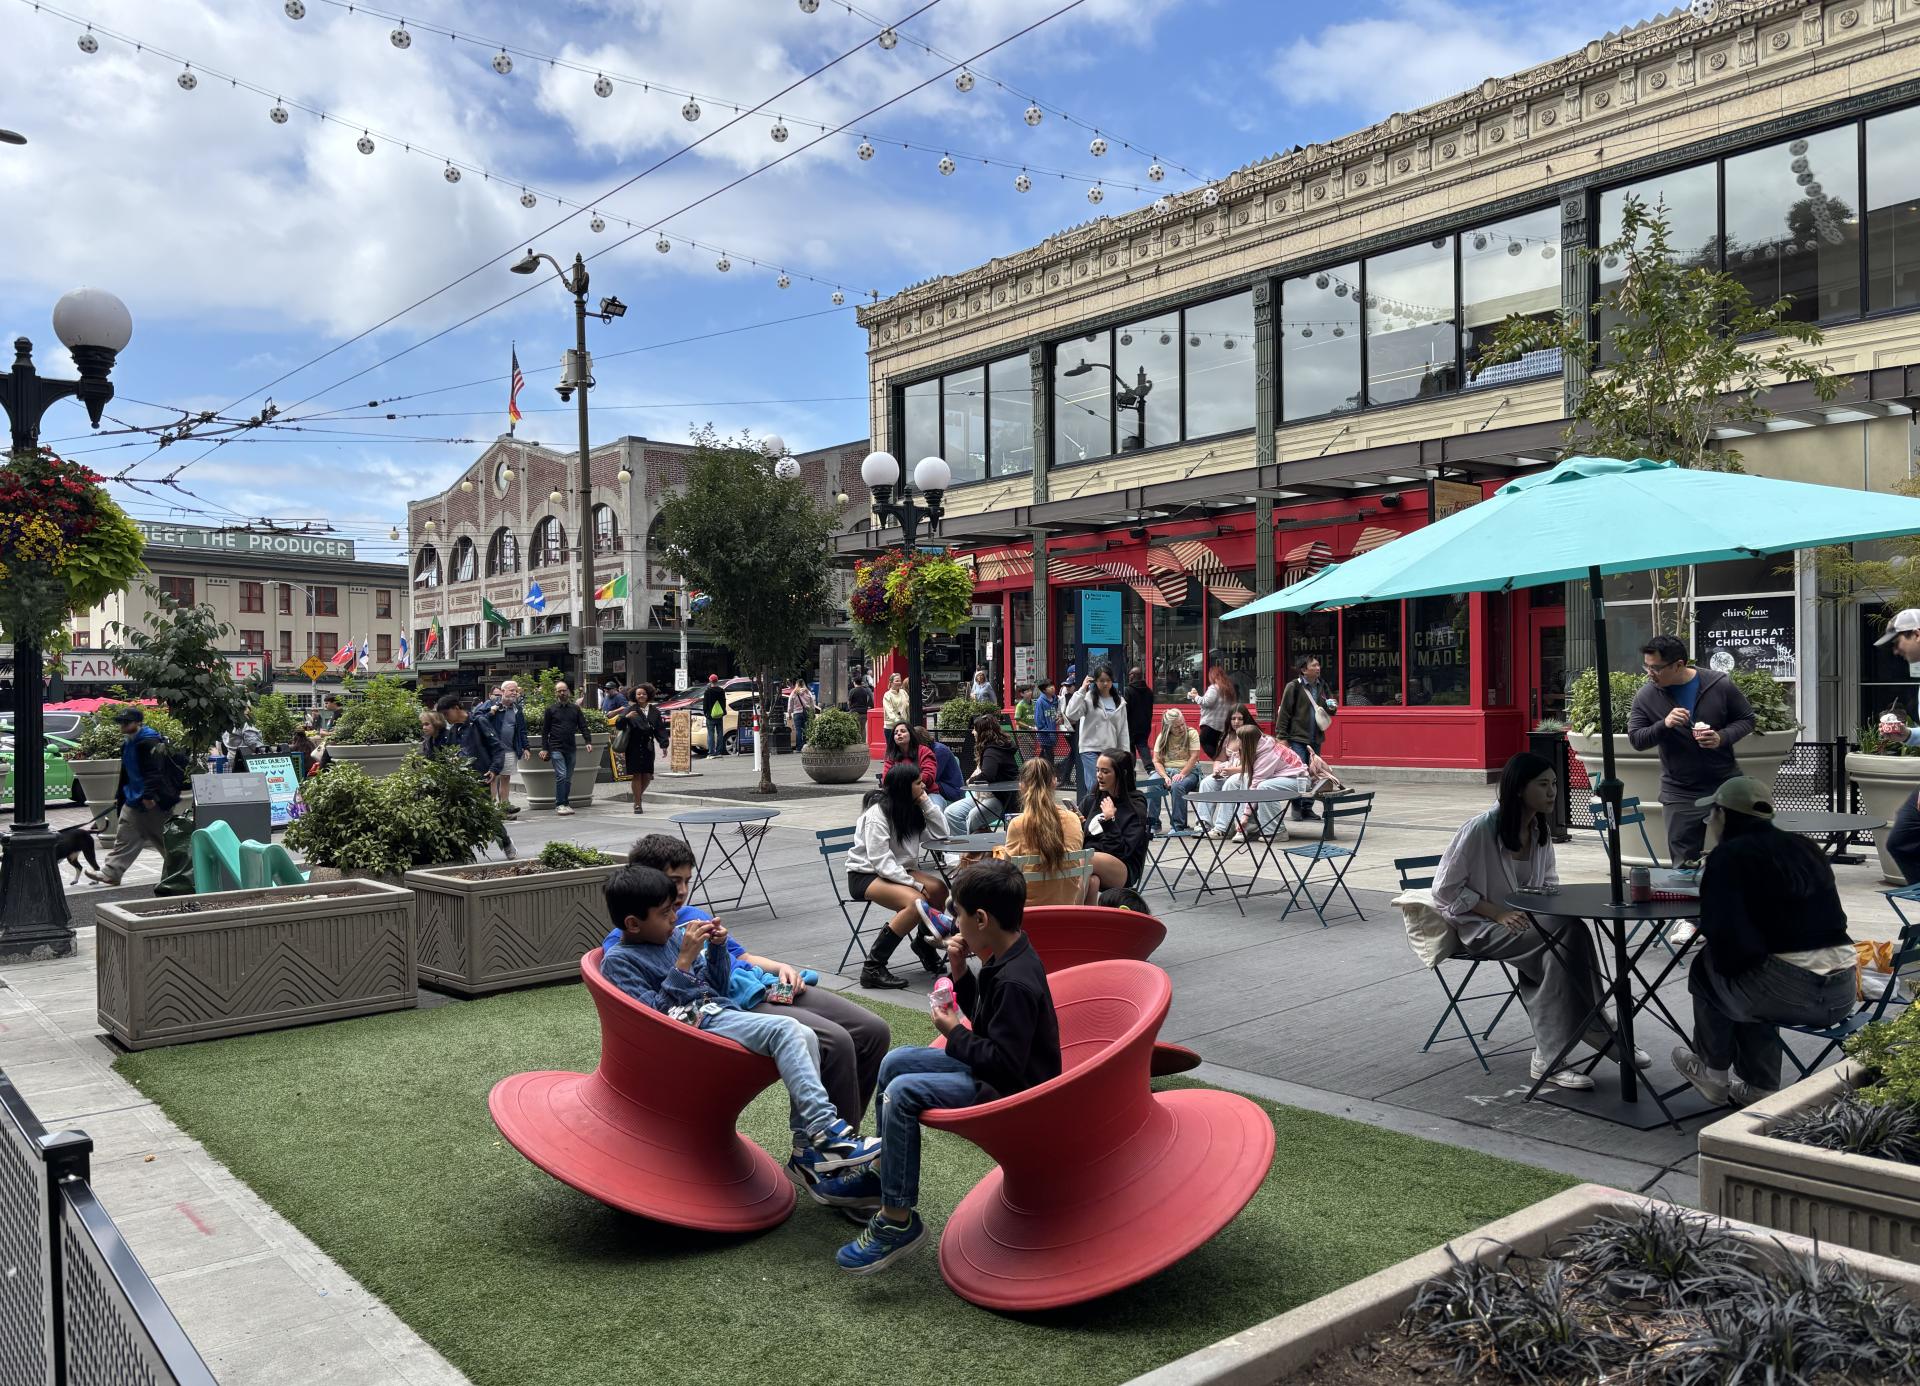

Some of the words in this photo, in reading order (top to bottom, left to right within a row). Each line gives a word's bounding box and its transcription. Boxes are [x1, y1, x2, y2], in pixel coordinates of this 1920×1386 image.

[200, 528, 236, 548] THE
[249, 534, 348, 557] PRODUCER
[1722, 608, 1747, 618] chiro
[1751, 609, 1769, 617] one
[1361, 633, 1386, 649] ICE
[1414, 629, 1466, 647] CRAFT
[1707, 630, 1728, 639] GET
[1730, 628, 1768, 638] RELIEF
[1770, 627, 1785, 636] AT
[1226, 639, 1247, 654] ICE
[1291, 635, 1336, 652] CRAFT
[1715, 638, 1750, 647] CHIRO
[1752, 637, 1777, 646] ONE
[1348, 651, 1401, 668] CREAM
[1417, 649, 1463, 667] MADE
[1686, 1061, 1698, 1075] N
